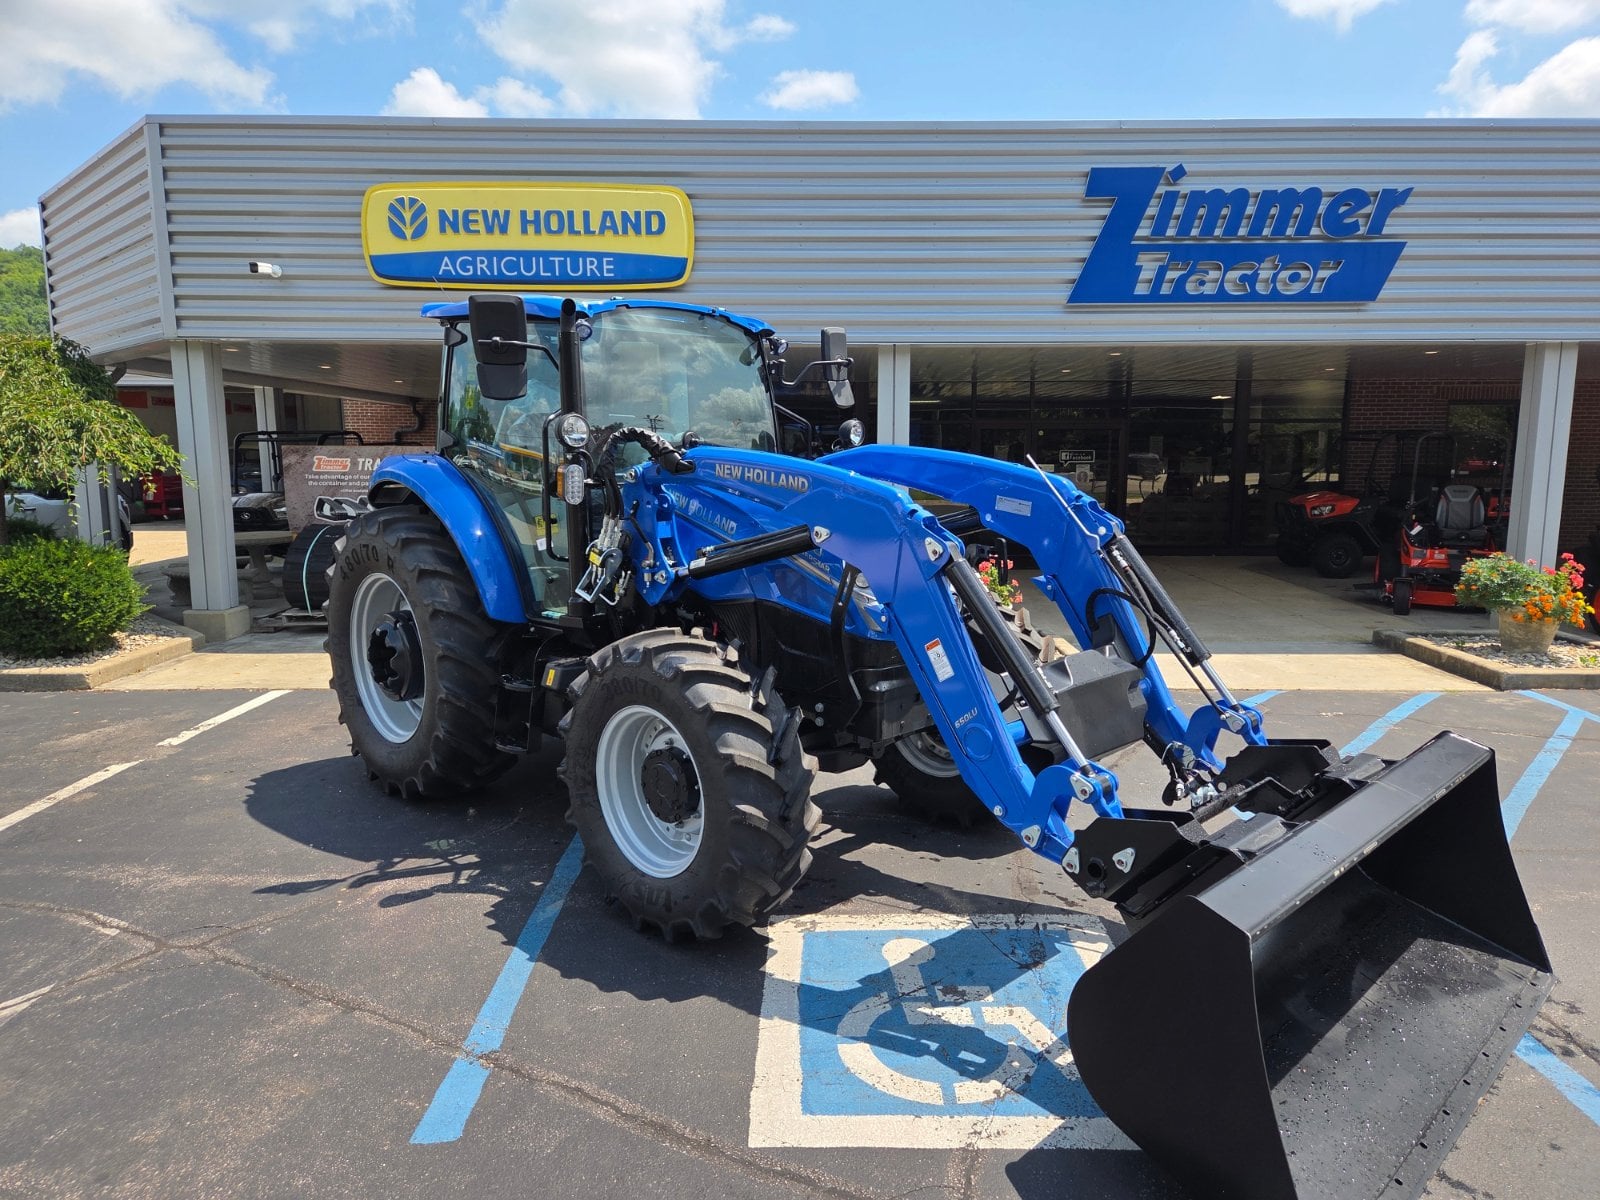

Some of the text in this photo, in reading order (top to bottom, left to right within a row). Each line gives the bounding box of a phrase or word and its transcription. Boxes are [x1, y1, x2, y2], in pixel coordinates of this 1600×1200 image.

[438, 209, 667, 236] NEW HOLLAND
[1067, 163, 1414, 303] Zimmer
[438, 256, 615, 277] AGRICULTURE
[1133, 252, 1344, 295] Tractor
[715, 463, 809, 493] NEW HOLLAND
[688, 499, 737, 534] HOLLAND
[340, 543, 380, 580] 480/70
[954, 706, 978, 729] 650LU
